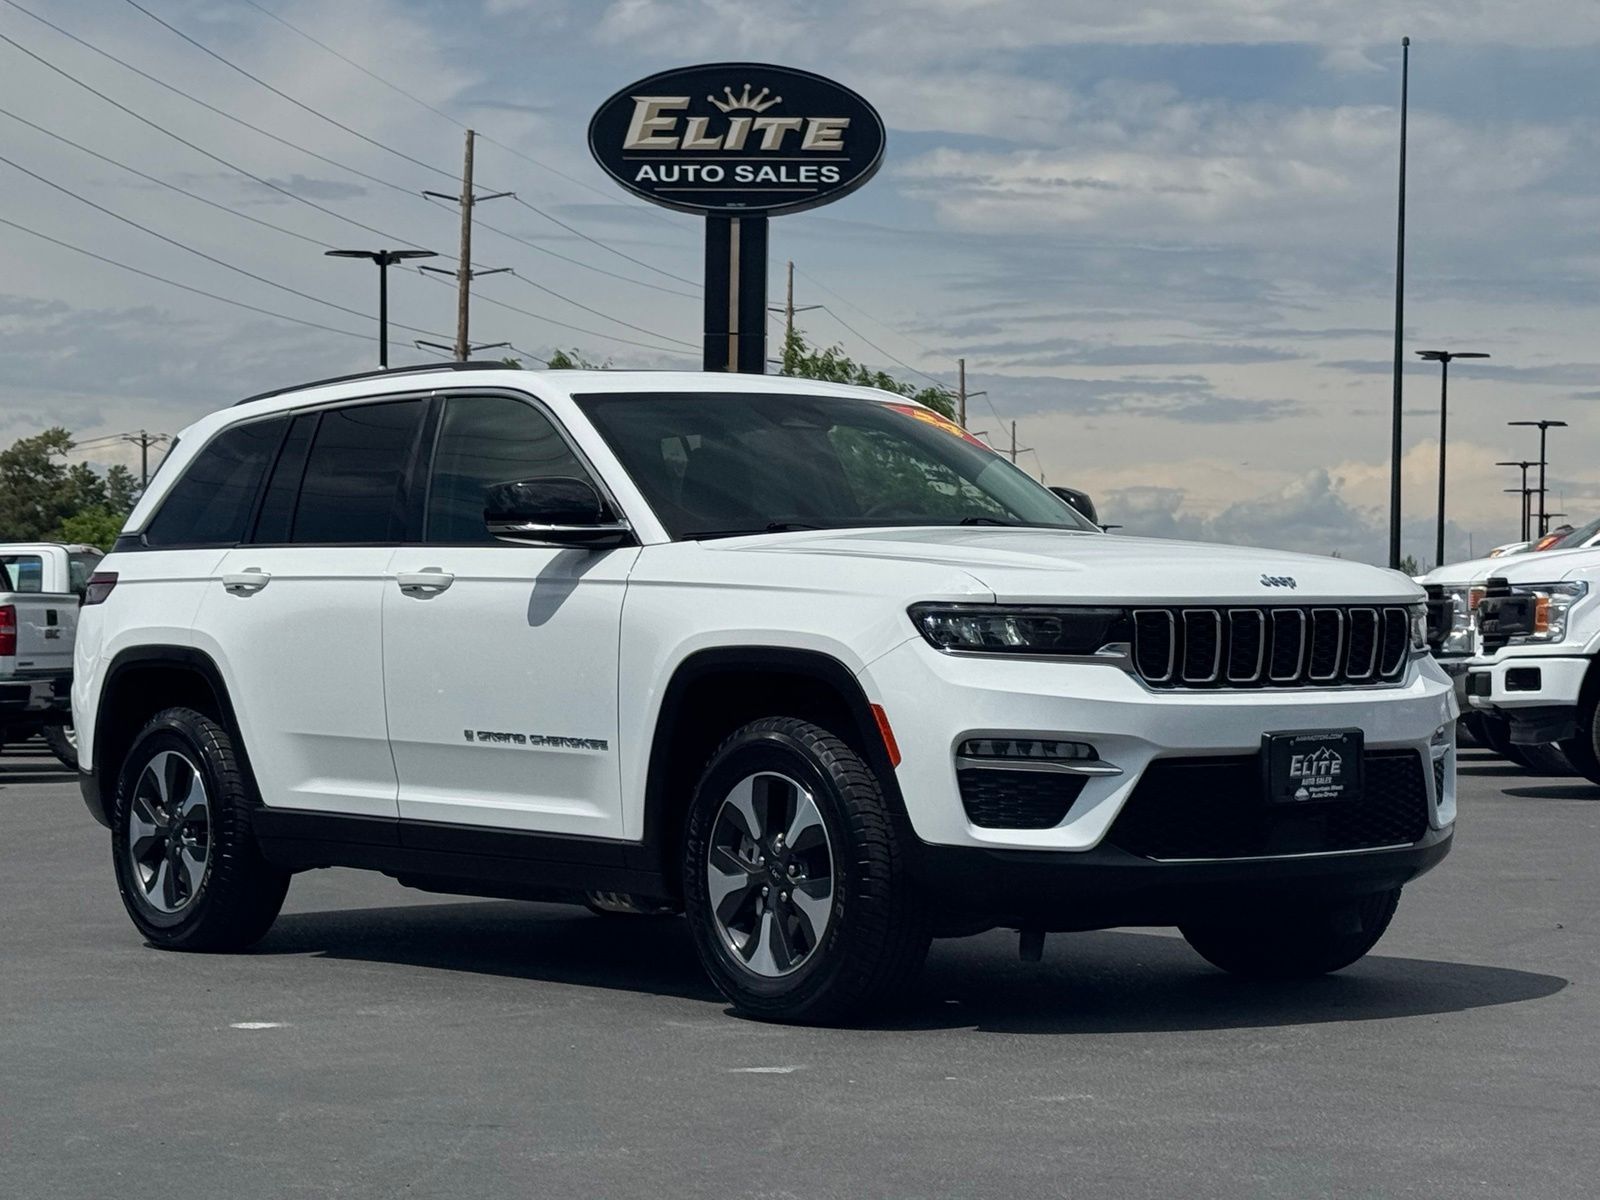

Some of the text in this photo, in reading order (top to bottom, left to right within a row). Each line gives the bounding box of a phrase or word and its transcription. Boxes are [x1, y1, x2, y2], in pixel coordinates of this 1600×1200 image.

[622, 96, 850, 150] ELITE
[634, 164, 841, 183] AUTO SALES
[1260, 574, 1297, 590] Jeep
[476, 731, 609, 751] GRAND CHEROKEE
[1289, 755, 1341, 777] ELITE
